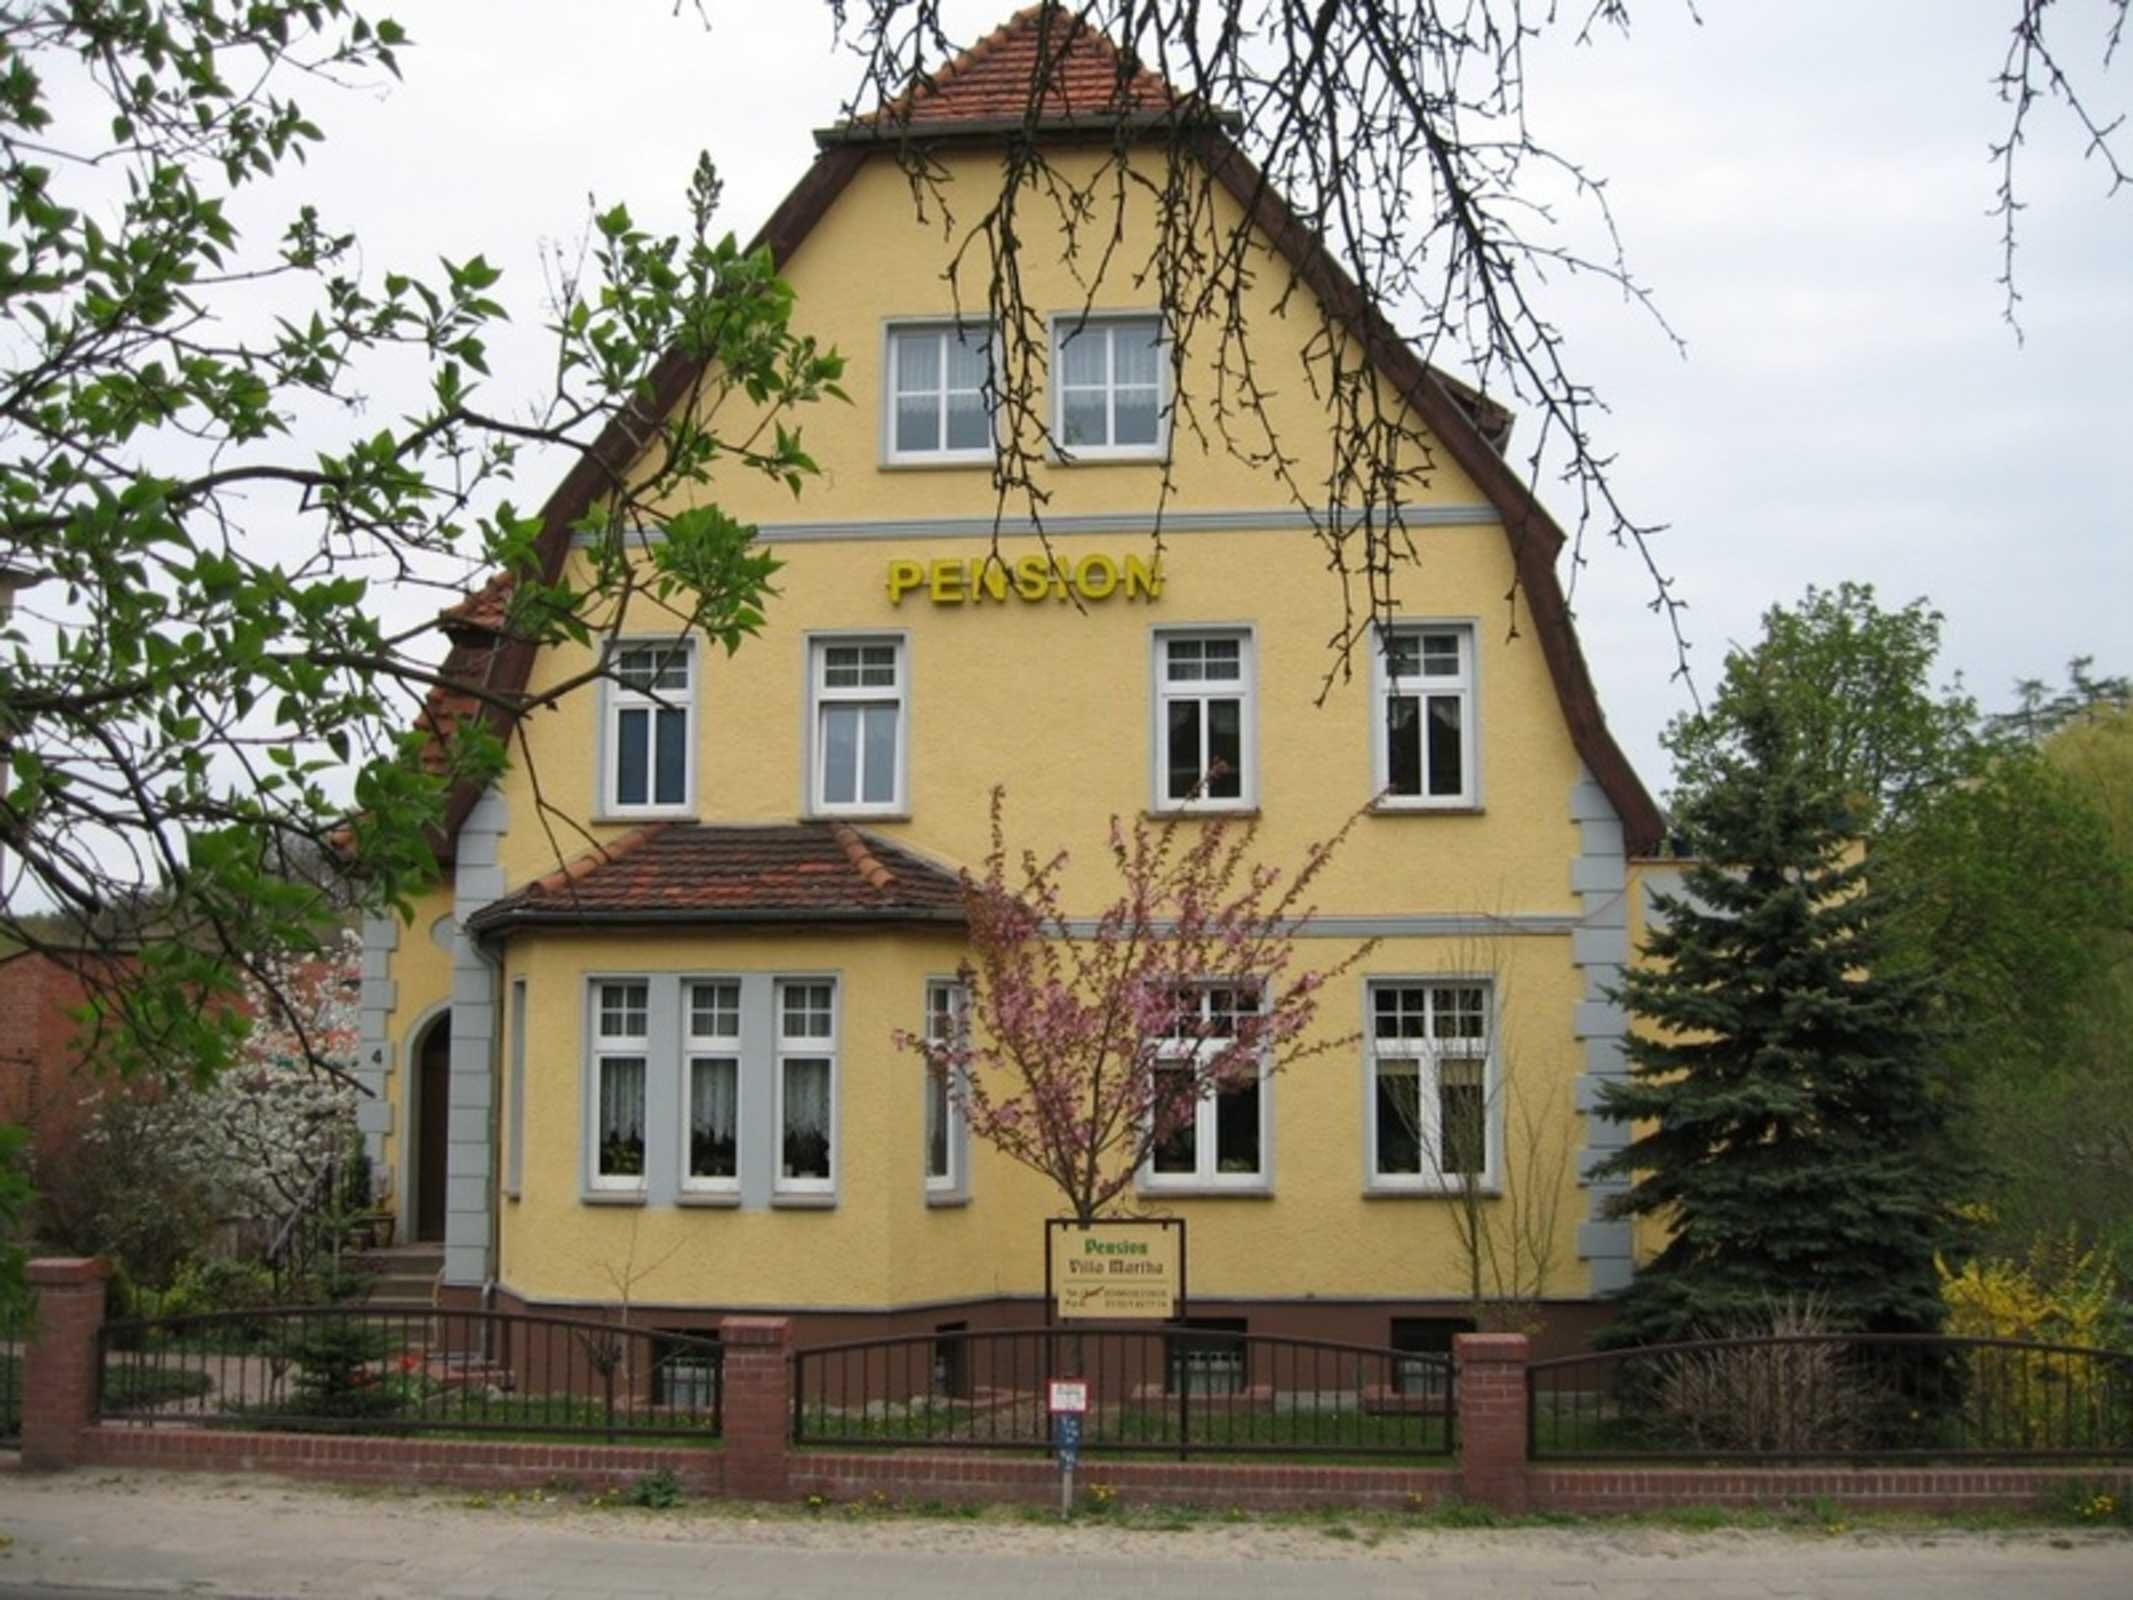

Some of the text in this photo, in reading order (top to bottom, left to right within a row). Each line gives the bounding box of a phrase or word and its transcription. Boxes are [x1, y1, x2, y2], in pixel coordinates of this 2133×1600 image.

[887, 553, 1164, 606] PENSION
[1084, 1238, 1148, 1255] Pension
[1069, 1259, 1164, 1275] Villa Martha
